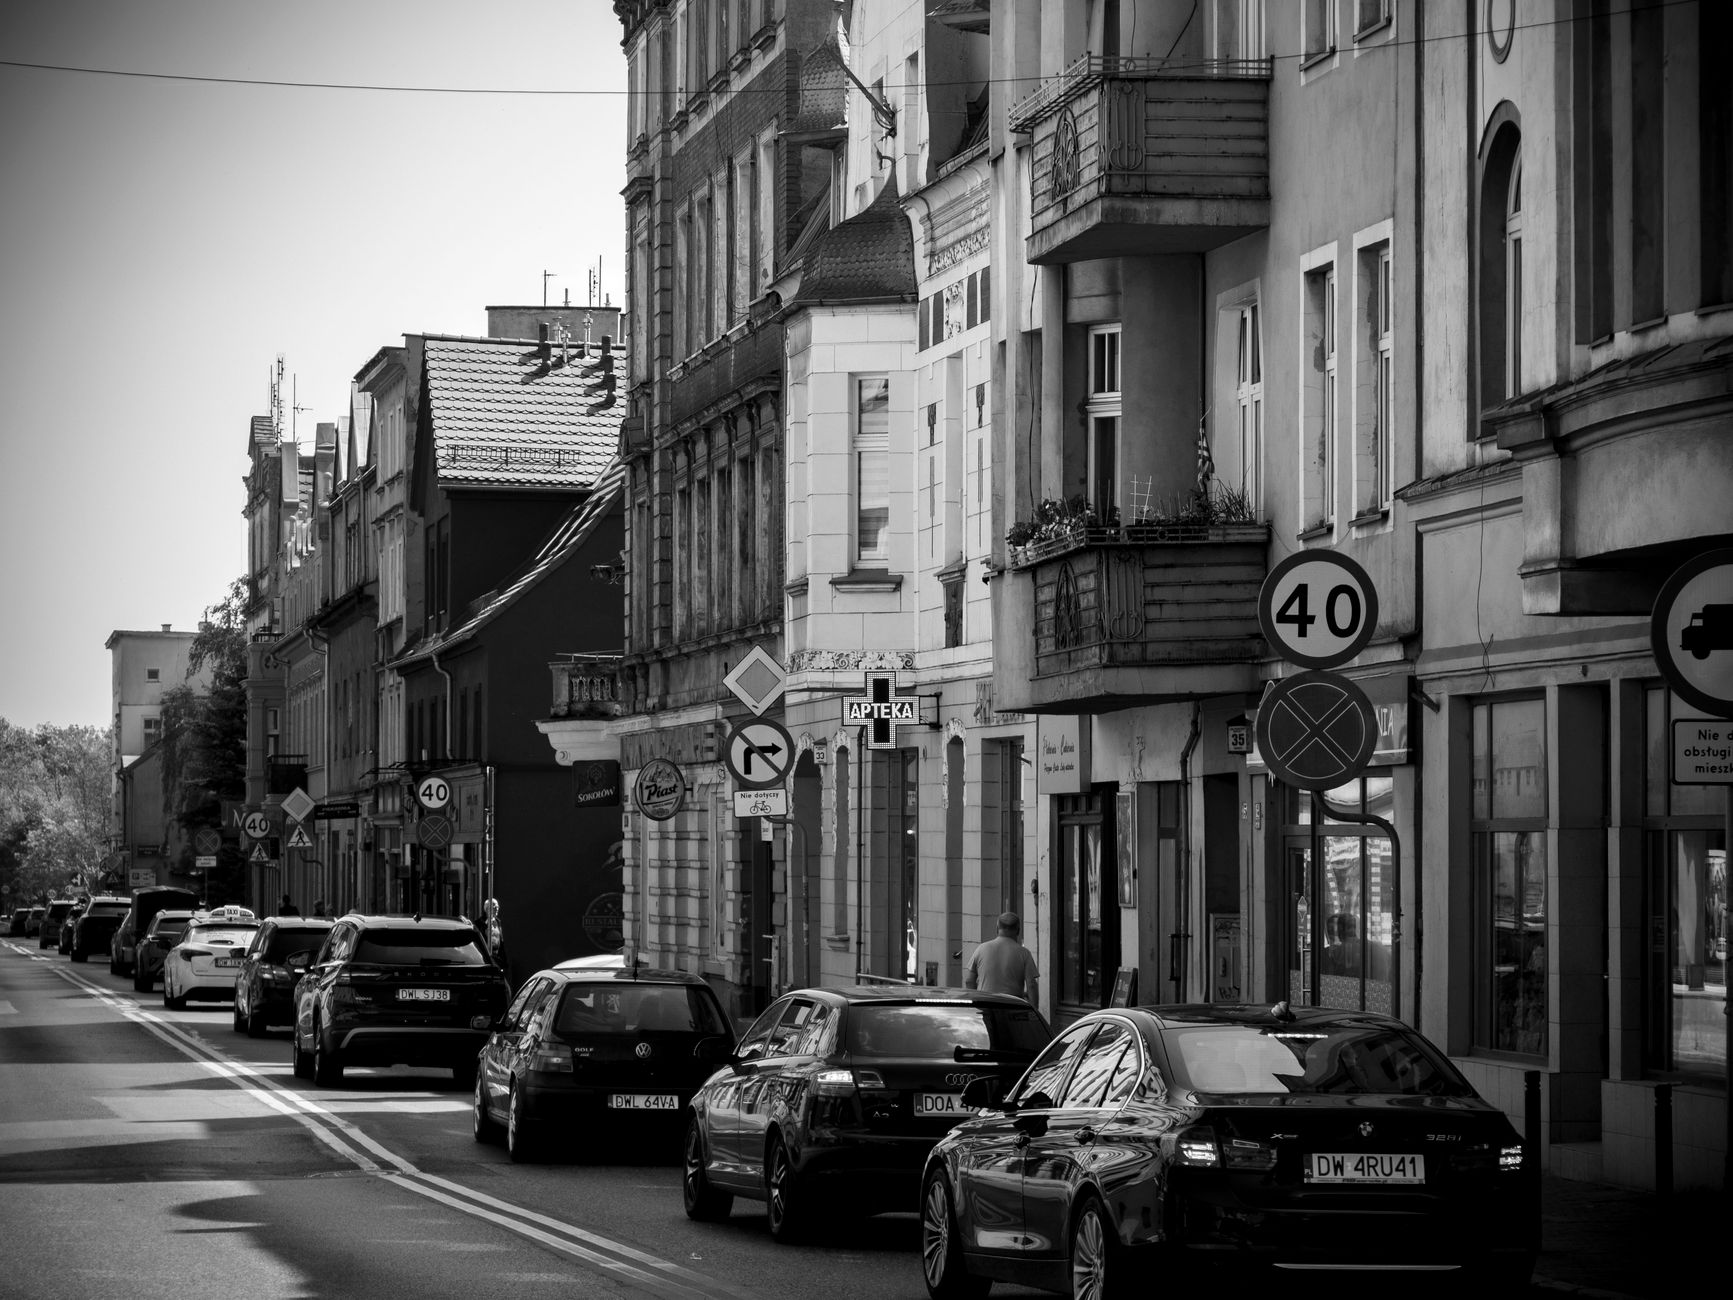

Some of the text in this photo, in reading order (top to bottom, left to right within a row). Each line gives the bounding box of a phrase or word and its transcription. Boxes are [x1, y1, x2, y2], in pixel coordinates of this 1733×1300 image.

[1276, 583, 1361, 638] 40
[850, 703, 913, 719] APTEKA
[1232, 733, 1245, 746] 35
[1698, 729, 1719, 741] Nie
[816, 752, 824, 760] 33
[1684, 746, 1731, 760] obsługi
[422, 784, 447, 802] 40
[645, 783, 678, 801] Piast
[740, 791, 779, 800] Nie dotyczy
[247, 818, 269, 833] 40
[401, 989, 449, 1000] DWL SJ38
[614, 1095, 640, 1108] DWL
[643, 1096, 676, 1109] 64VA
[924, 1095, 955, 1112] DOA
[1317, 1154, 1418, 1178] DW 4RU41
